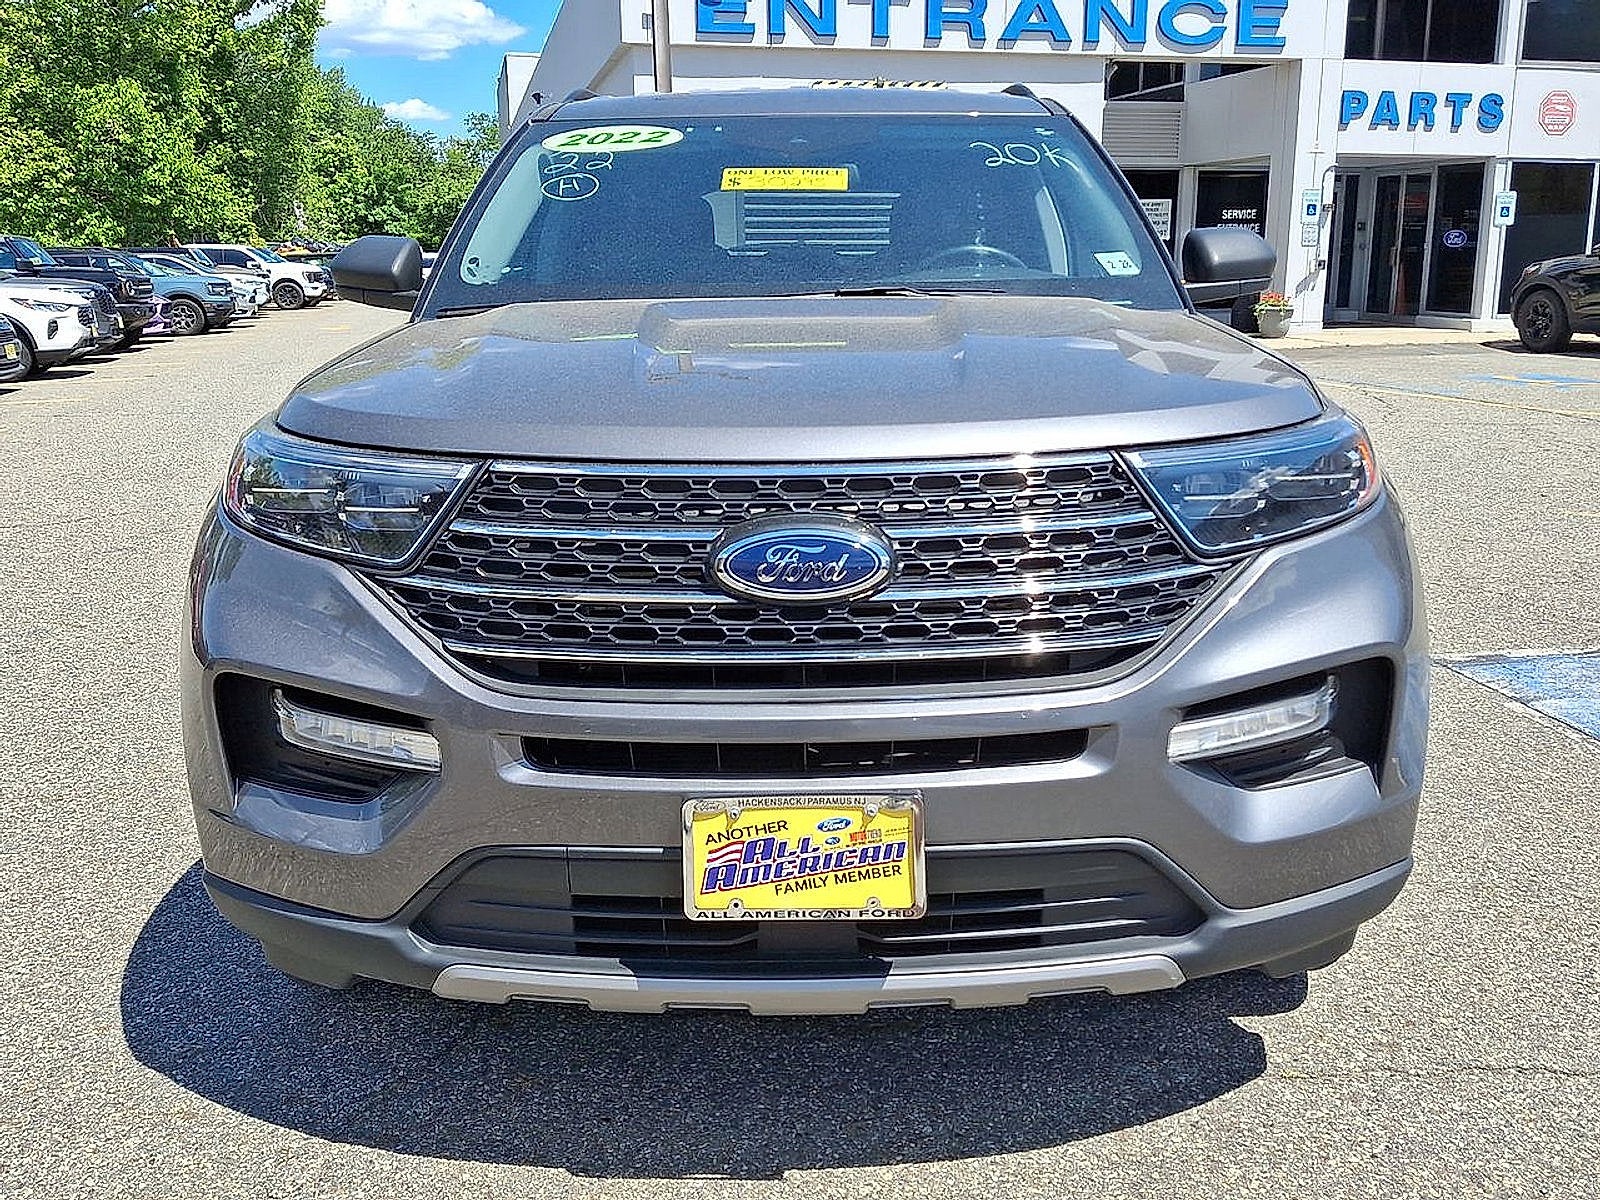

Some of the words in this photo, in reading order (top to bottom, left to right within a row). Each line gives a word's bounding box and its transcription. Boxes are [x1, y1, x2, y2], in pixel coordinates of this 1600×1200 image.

[695, 0, 1289, 52] ENTRANCE
[1338, 90, 1505, 132] PARTS
[557, 130, 671, 148] 2022
[1221, 209, 1258, 220] SERVICE
[756, 543, 850, 583] Ford
[704, 819, 789, 846] ANOTHER
[821, 820, 848, 832] Ford
[742, 836, 821, 864] ALL
[703, 841, 907, 891] AMERICAN
[774, 874, 829, 897] FAMILY
[834, 864, 902, 886] MEMBER
[696, 909, 729, 919] ALL
[741, 909, 851, 919] AMERICAN
[858, 908, 915, 918] FORD
